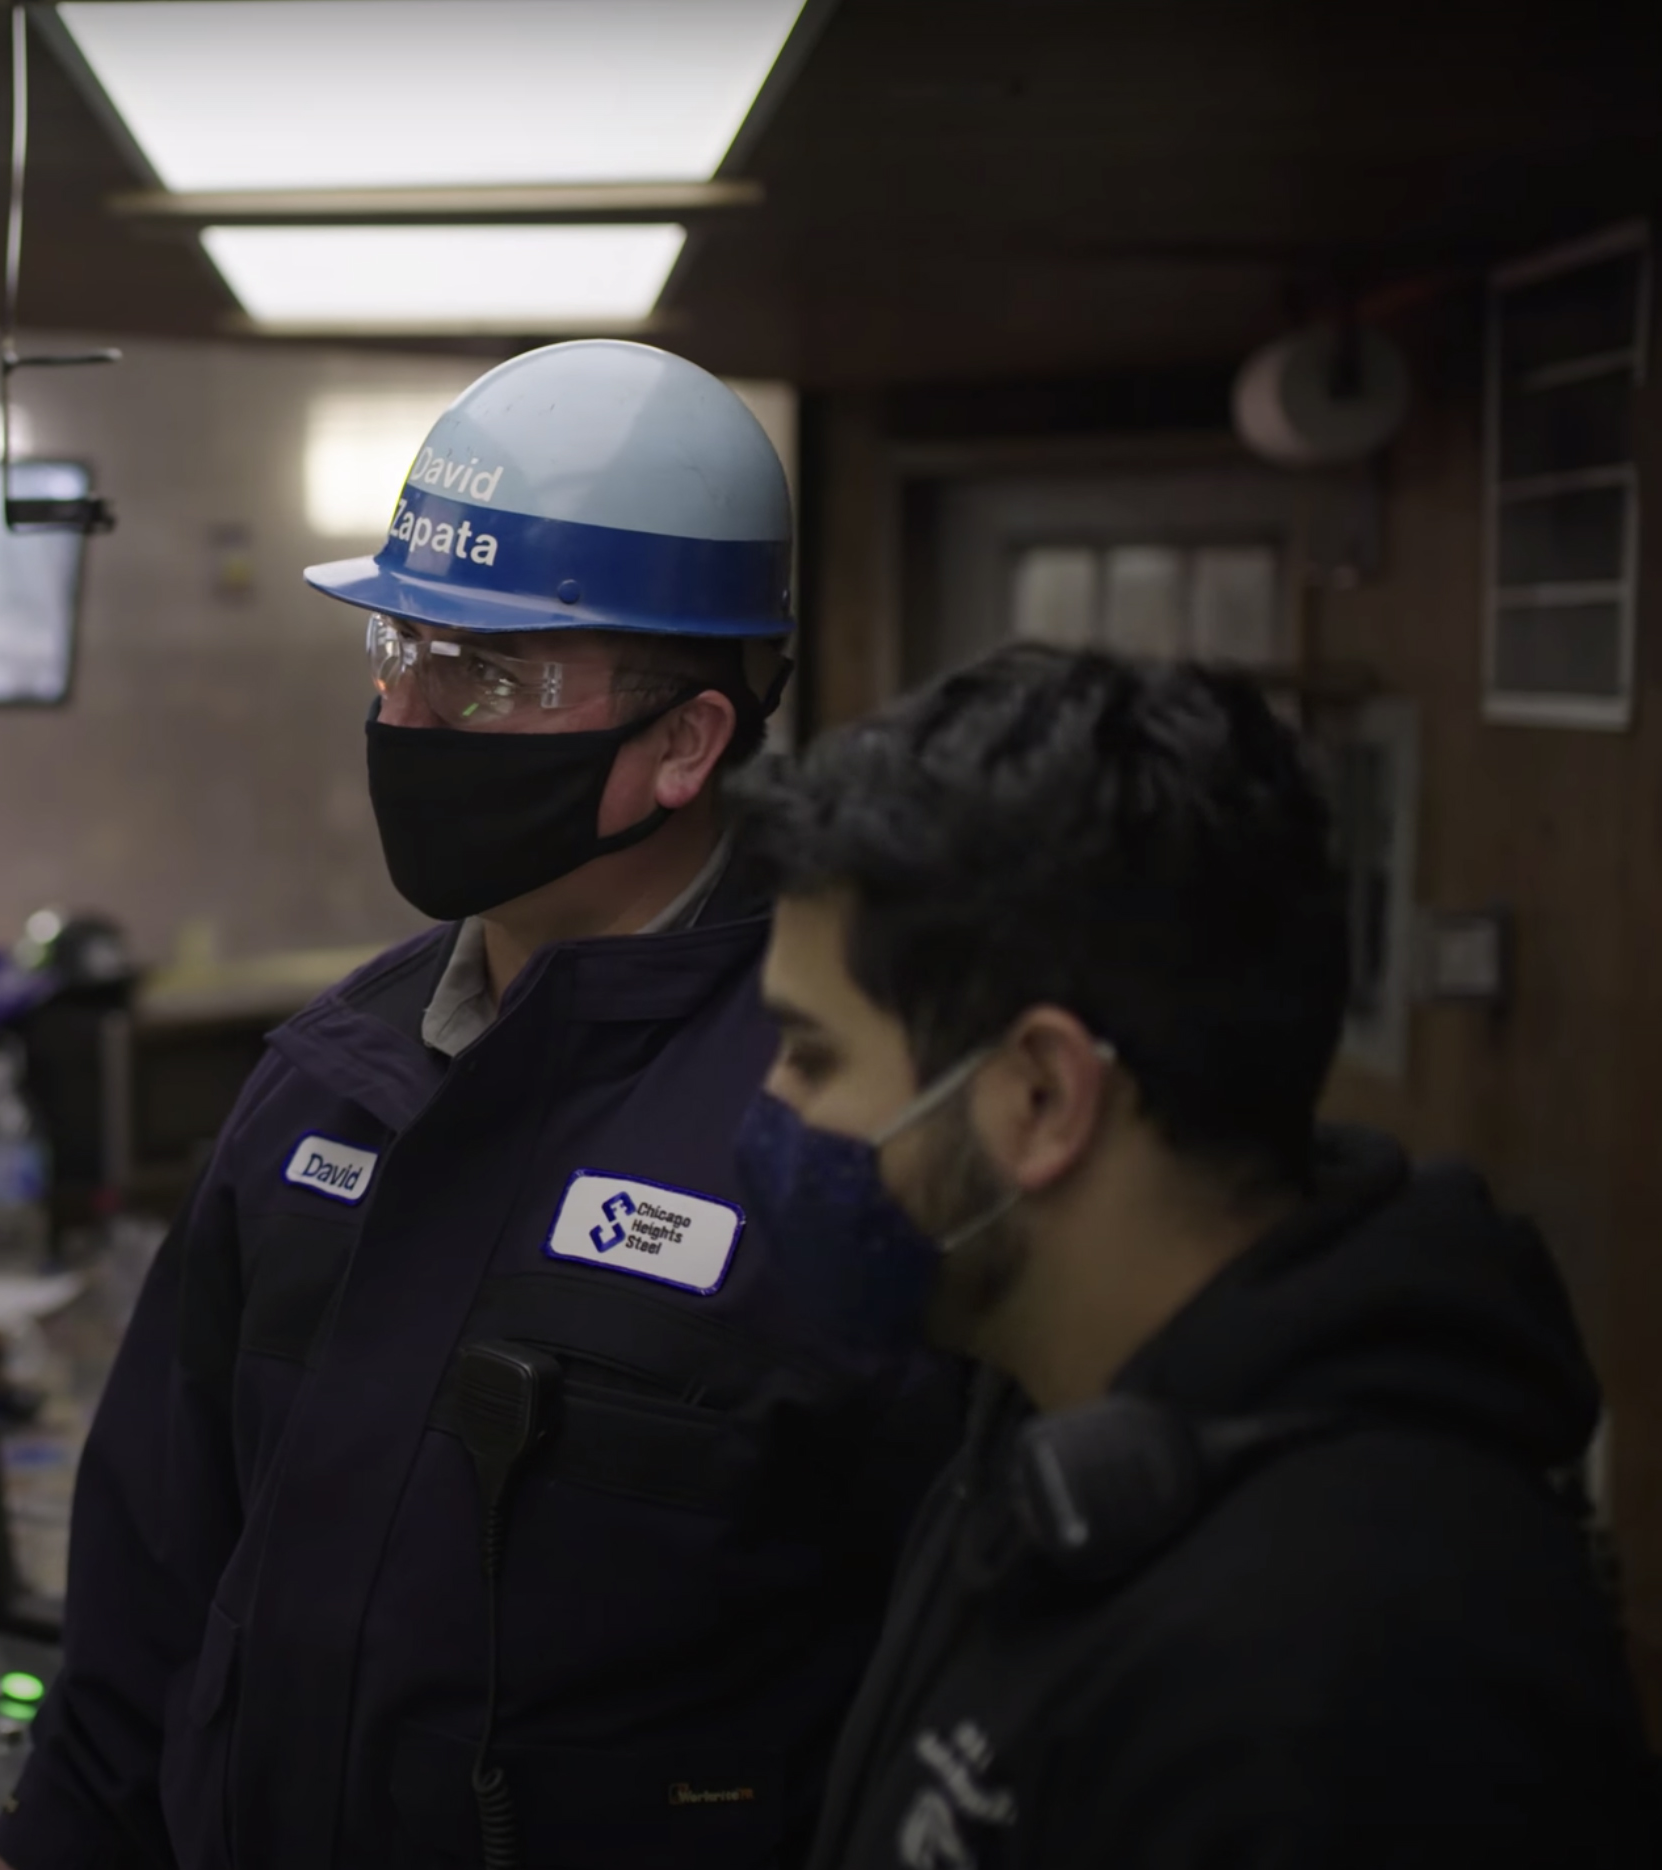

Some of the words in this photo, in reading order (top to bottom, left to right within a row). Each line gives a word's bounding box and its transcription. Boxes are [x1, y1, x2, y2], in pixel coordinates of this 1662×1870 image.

[409, 446, 504, 502] David
[390, 497, 499, 567] Zapata
[302, 1152, 364, 1192] David
[631, 1219, 683, 1244] Heights
[637, 1202, 691, 1228] Chicago
[625, 1235, 662, 1255] Steel
